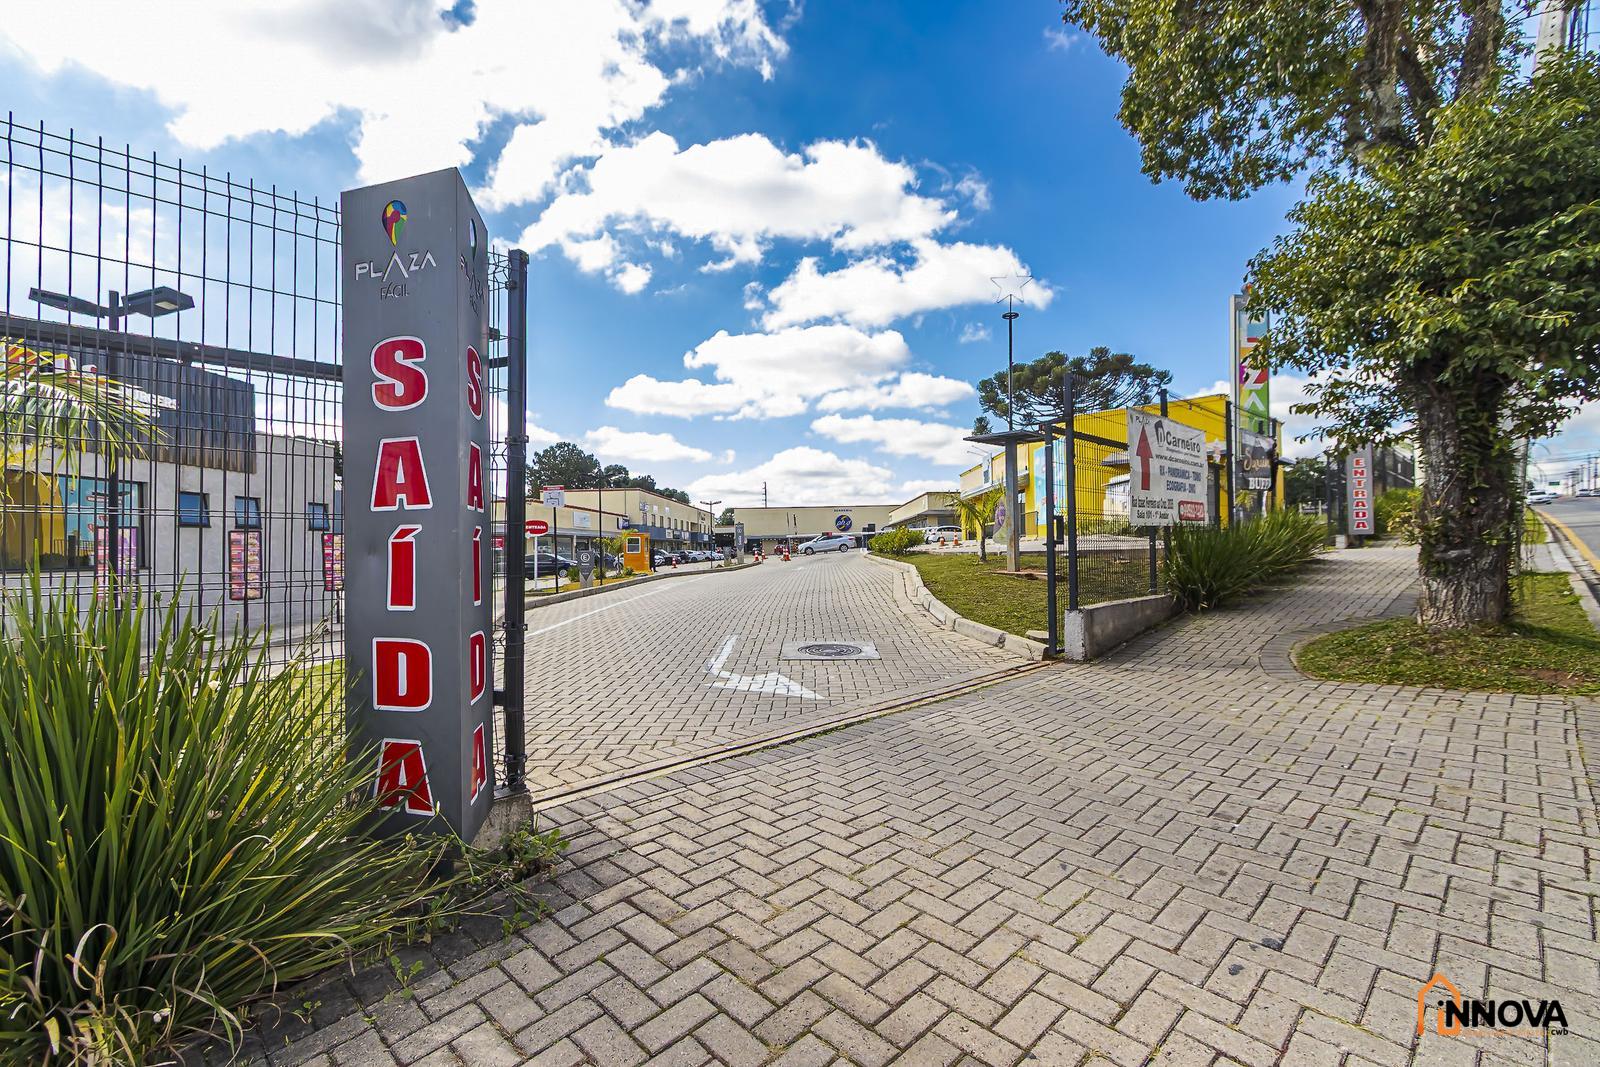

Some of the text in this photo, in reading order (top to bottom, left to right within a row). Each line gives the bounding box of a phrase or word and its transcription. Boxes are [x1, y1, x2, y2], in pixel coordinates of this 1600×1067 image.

[355, 250, 437, 282] PLAZA
[380, 283, 410, 300] FÁCIL
[1353, 457, 1369, 530] ENTRADA
[370, 335, 436, 817] SAÍDA
[466, 344, 486, 806] SAÍDA
